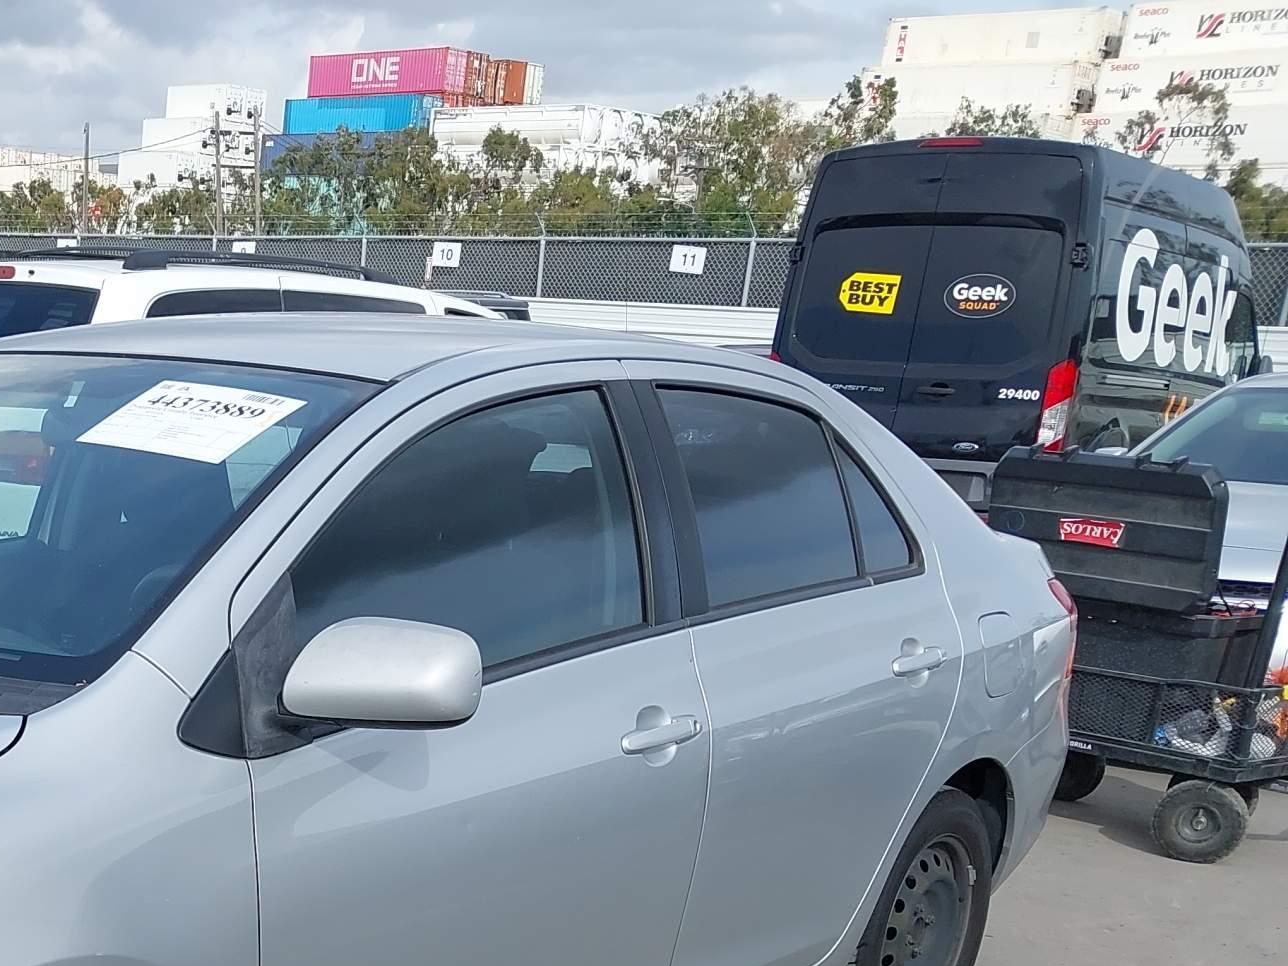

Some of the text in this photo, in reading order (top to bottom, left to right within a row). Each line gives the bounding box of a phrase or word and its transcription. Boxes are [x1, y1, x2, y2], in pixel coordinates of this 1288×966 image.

[1138, 7, 1169, 17] seaco
[350, 56, 401, 82] ONE
[1110, 63, 1140, 72] seaco
[1200, 64, 1280, 81] HORIZON
[1168, 123, 1248, 138] HORIZON
[440, 248, 454, 261] 10
[682, 252, 697, 267] 11
[848, 279, 898, 294] BEST
[952, 282, 1010, 302] Geek
[847, 293, 891, 308] BUY
[959, 301, 998, 310] SQUAD
[1116, 229, 1238, 377] Geek
[998, 388, 1041, 401] 29400
[148, 394, 266, 418] 44373889
[1062, 522, 1122, 543] CARLOS
[1069, 740, 1092, 750] ORILLA
